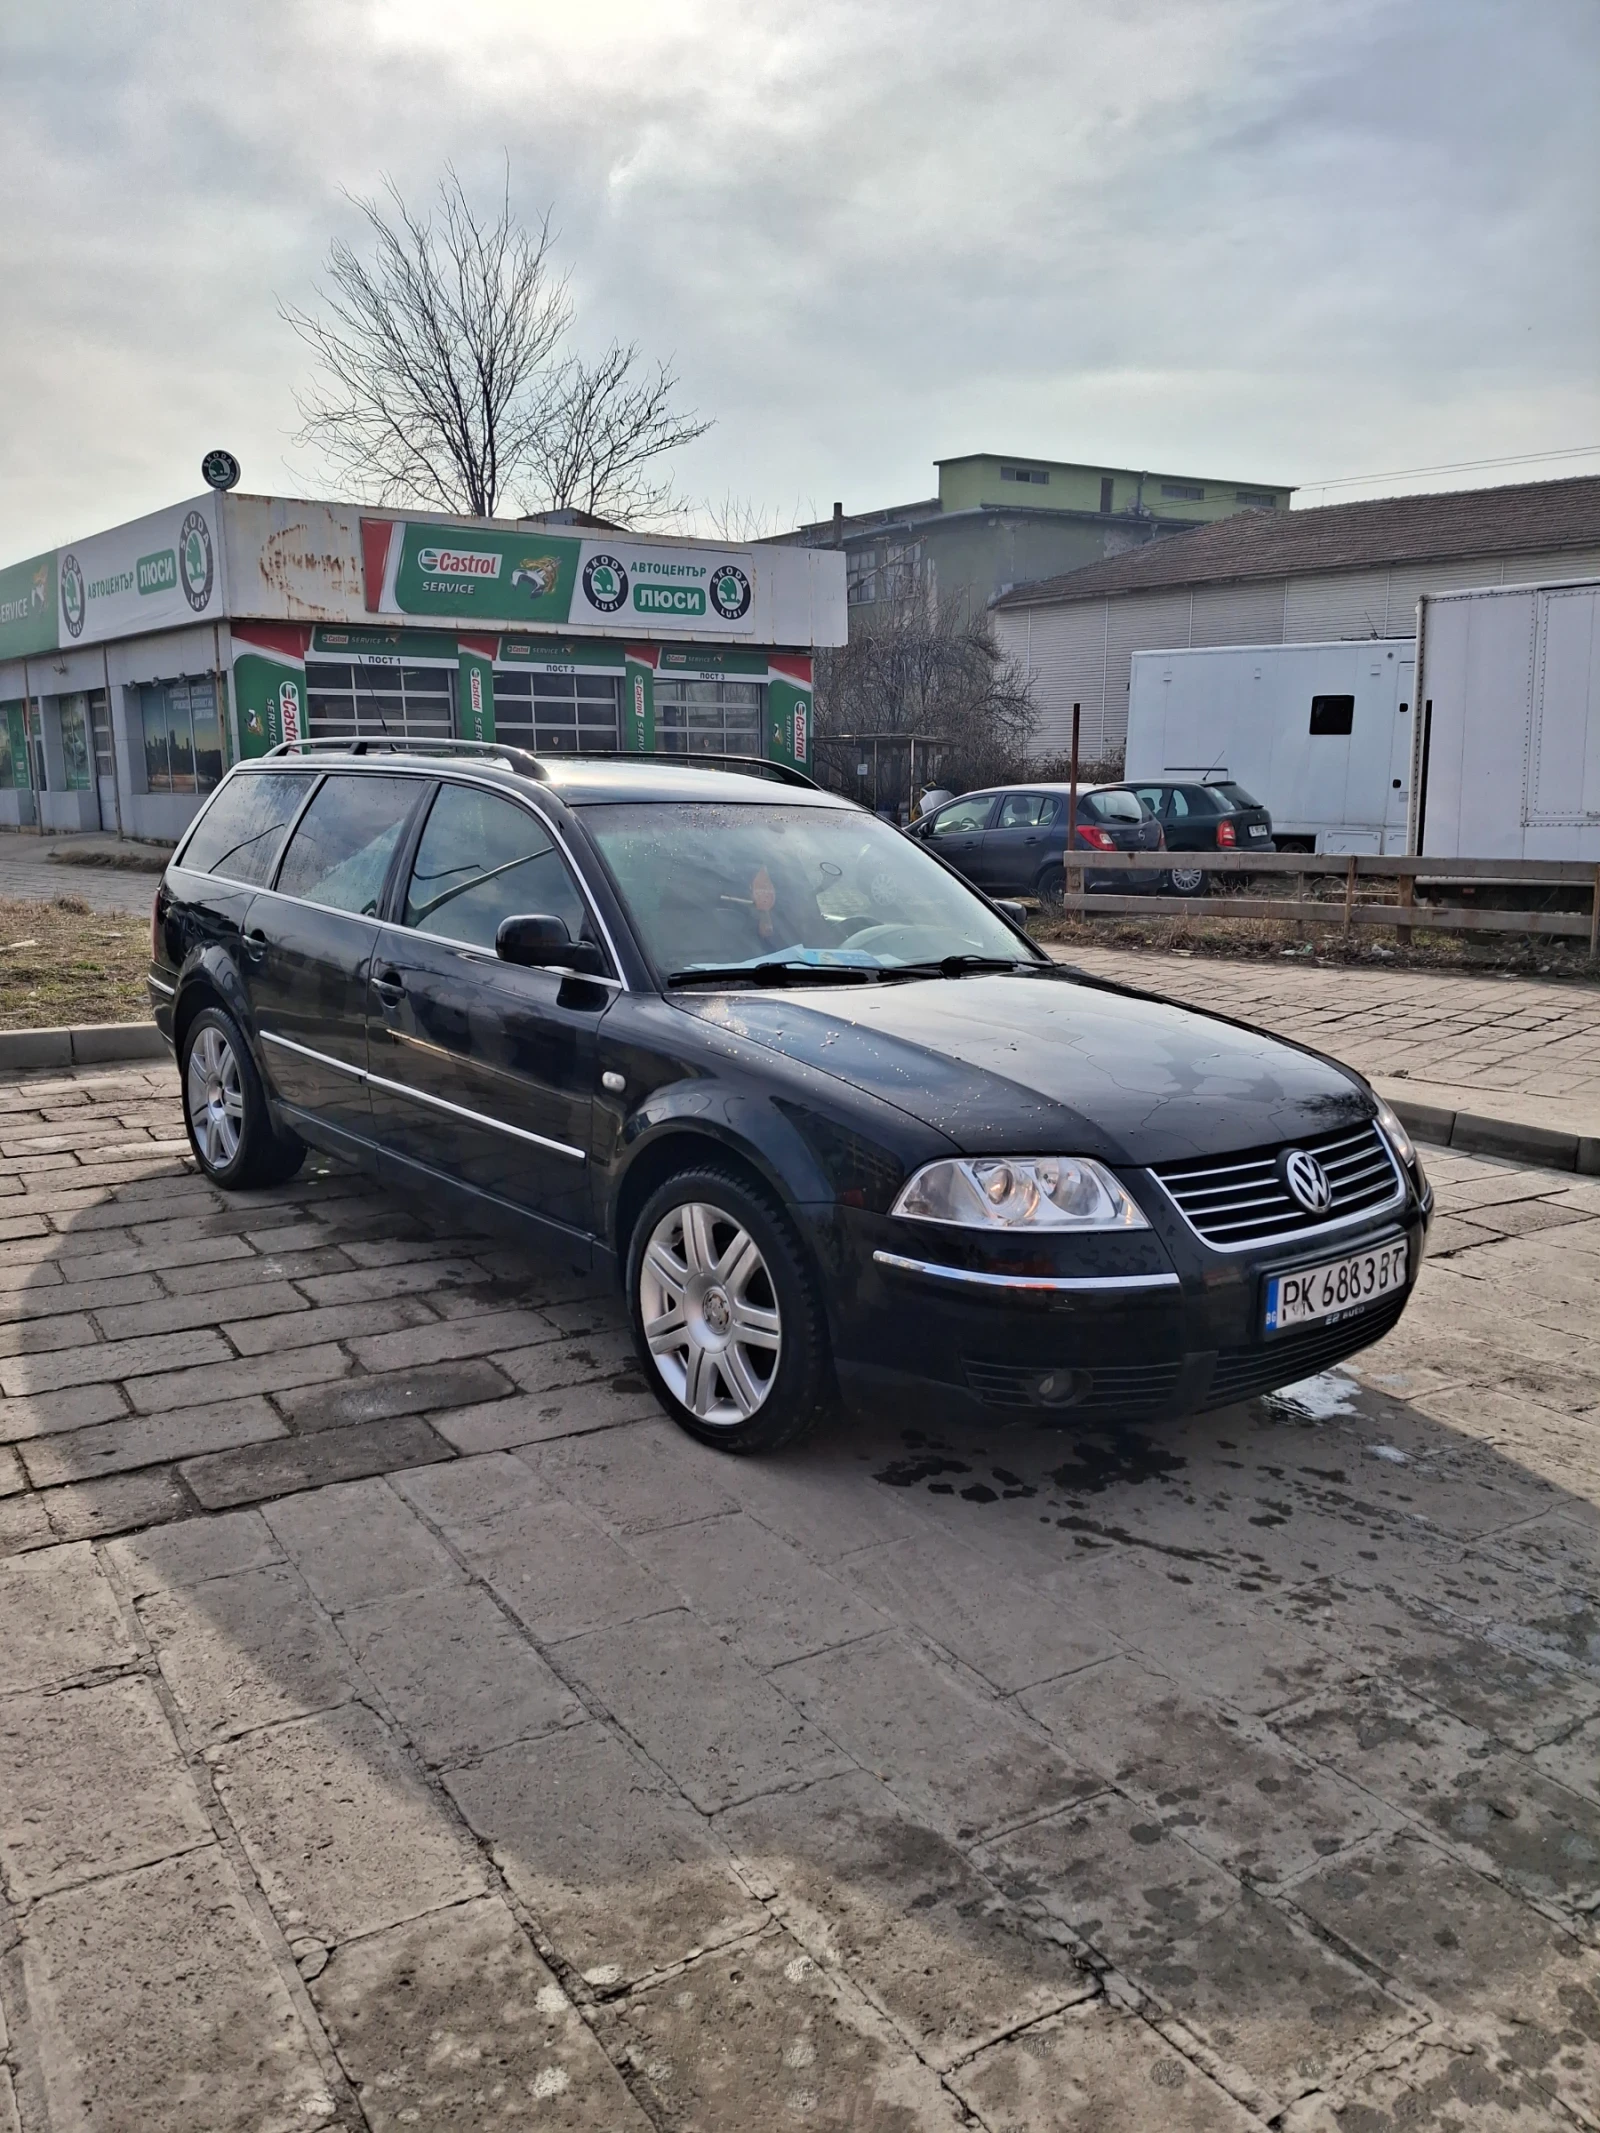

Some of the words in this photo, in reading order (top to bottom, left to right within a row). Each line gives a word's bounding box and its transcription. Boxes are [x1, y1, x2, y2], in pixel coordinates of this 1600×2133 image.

[139, 556, 174, 588] ЛЮСИ
[440, 552, 496, 574] Castrol
[630, 561, 707, 577] АВТОЦЕНТЪР
[87, 571, 134, 600] АВТОЦЕНТЪР
[422, 581, 475, 594] SERVICE
[190, 592, 208, 609] LUSI
[595, 600, 618, 611] LUSI
[639, 589, 700, 610] ЛЮСИ
[0, 597, 28, 623] ERVICE
[720, 608, 742, 619] LUSI
[69, 621, 82, 637] LUSI
[327, 634, 348, 643] Castrol
[351, 636, 382, 644] SERVICE
[368, 656, 393, 665] ПОСТ
[397, 657, 401, 665] 1
[546, 664, 569, 672] ПОСТ
[570, 665, 575, 673] 2
[700, 672, 719, 680] ПОСТ
[471, 678, 482, 710] Castrol
[635, 685, 644, 716] Castrol
[266, 698, 278, 747] SERVICE
[474, 717, 483, 742] SER
[794, 716, 806, 759] Castrol
[1322, 1258, 1375, 1307] 6883
[1265, 1311, 1277, 1325] BG
